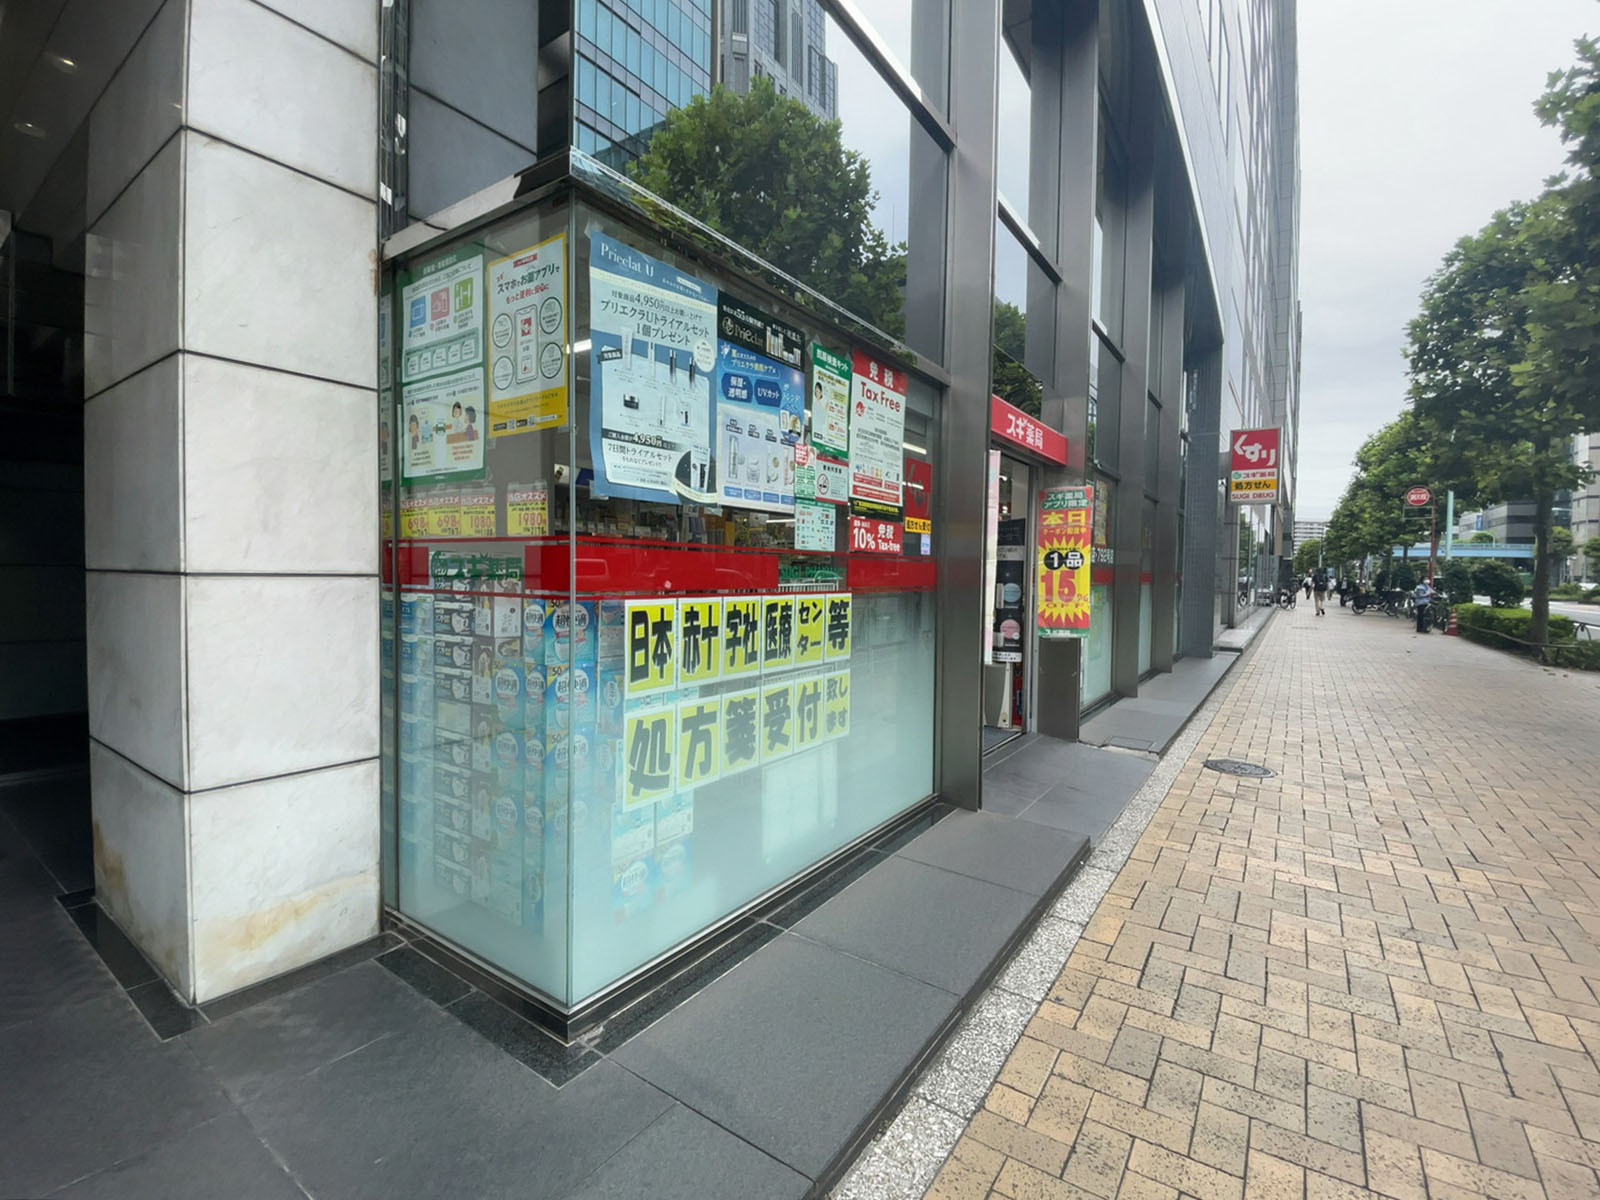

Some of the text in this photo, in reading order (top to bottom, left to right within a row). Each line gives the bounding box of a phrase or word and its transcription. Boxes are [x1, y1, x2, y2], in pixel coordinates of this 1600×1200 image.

[860, 381, 901, 413] Tax Free
[1006, 412, 1043, 450] スギ薬局
[1234, 434, 1276, 467] くすり
[1235, 481, 1271, 490] 処方せん
[518, 511, 543, 526] 1980
[1042, 510, 1086, 528] 本日
[853, 527, 876, 550] 10%
[1050, 551, 1083, 568] 1品
